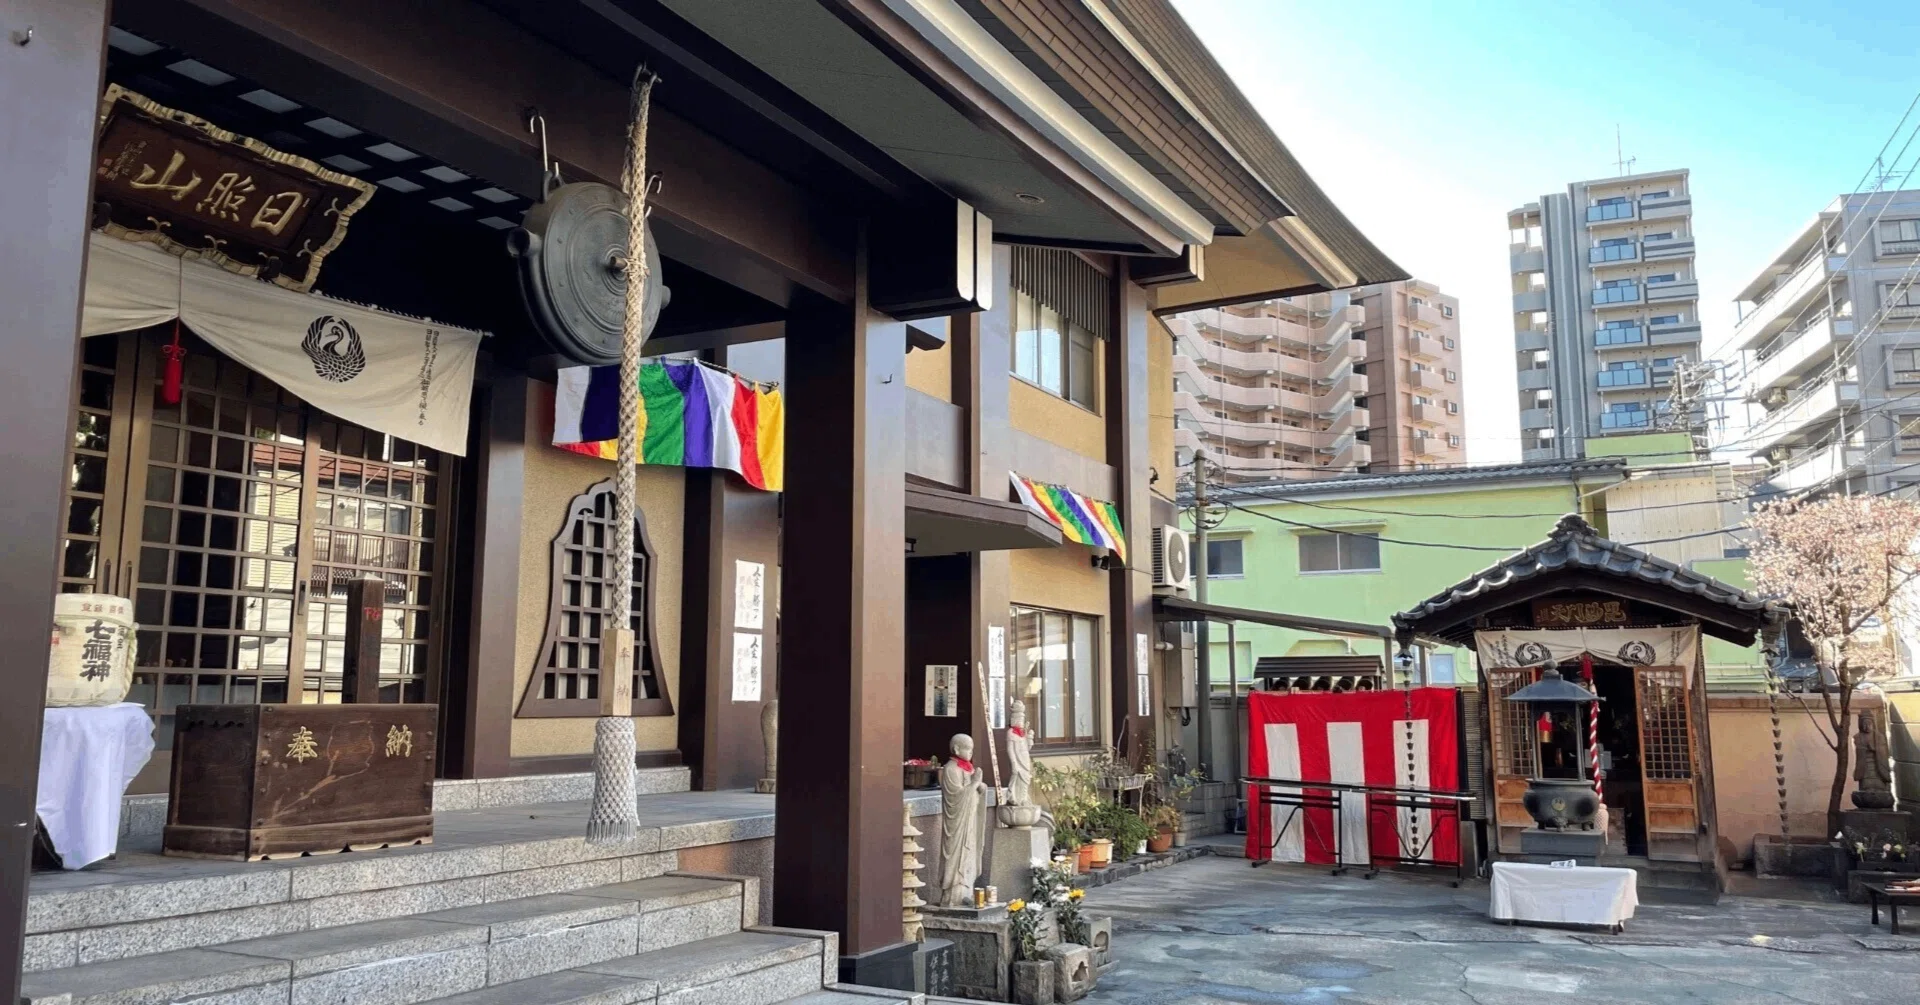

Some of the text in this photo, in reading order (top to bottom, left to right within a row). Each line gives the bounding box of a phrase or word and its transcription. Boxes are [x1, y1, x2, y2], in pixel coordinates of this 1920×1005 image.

[130, 150, 303, 236] 日照山
[79, 619, 116, 682] 七福神
